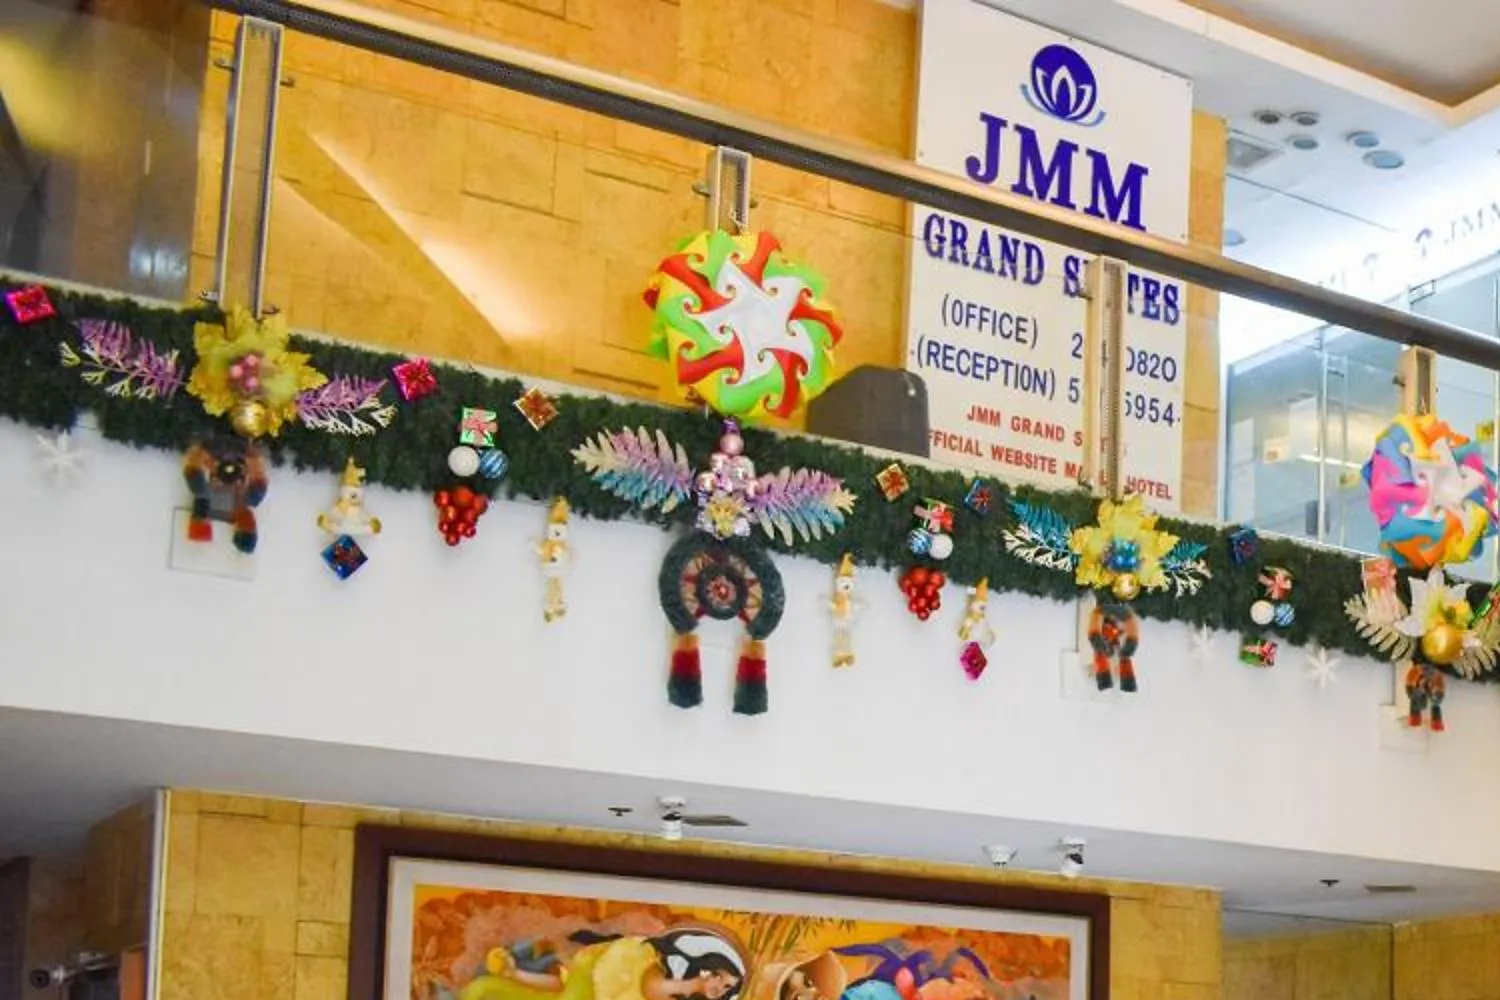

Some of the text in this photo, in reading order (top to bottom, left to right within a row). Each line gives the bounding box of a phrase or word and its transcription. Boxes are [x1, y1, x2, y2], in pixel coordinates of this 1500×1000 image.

[965, 112, 1149, 232] JMM
[923, 213, 1180, 326] GRAND STES
[942, 293, 1038, 350] (OFFICE)
[917, 335, 1056, 401] (RECEPTION)
[928, 429, 983, 457] FICIAL
[991, 444, 1057, 474] WEBSITE
[967, 404, 1065, 442] JMM GRAND
[1128, 475, 1173, 500] HOTEL
